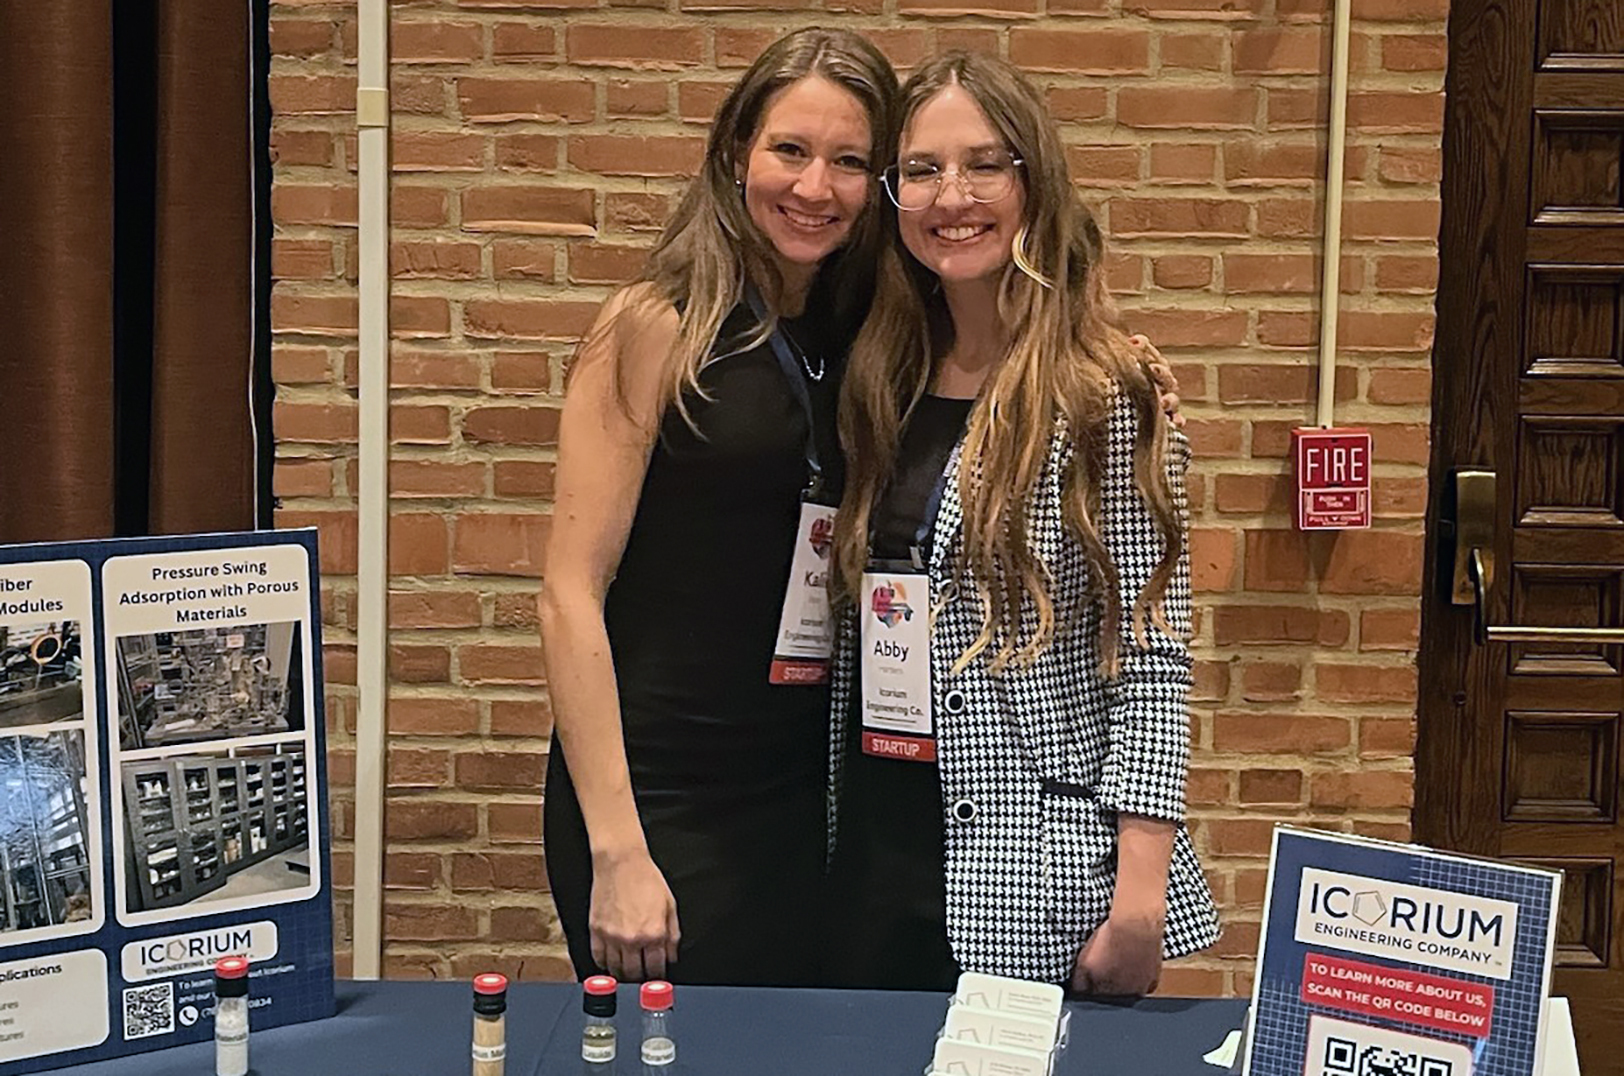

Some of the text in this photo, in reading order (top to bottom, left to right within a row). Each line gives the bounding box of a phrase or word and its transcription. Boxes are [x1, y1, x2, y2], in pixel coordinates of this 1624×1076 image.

[1306, 447, 1363, 483] FIRE
[152, 560, 267, 580] Pressure Swing
[0, 578, 33, 592] iber
[118, 580, 299, 606] Adsorption with Porous
[176, 604, 248, 623] Materials
[873, 639, 909, 662] Abby
[871, 738, 921, 757] STARTUP
[1314, 922, 1492, 965] ENGINEERING COMPANY
[0, 964, 63, 983] plications
[145, 960, 205, 975] ENGINEERING
[1309, 962, 1487, 1008] TO LEARN MORE ABOUT US,
[1306, 982, 1486, 1028] SCAN THE QR CODE BELOW
